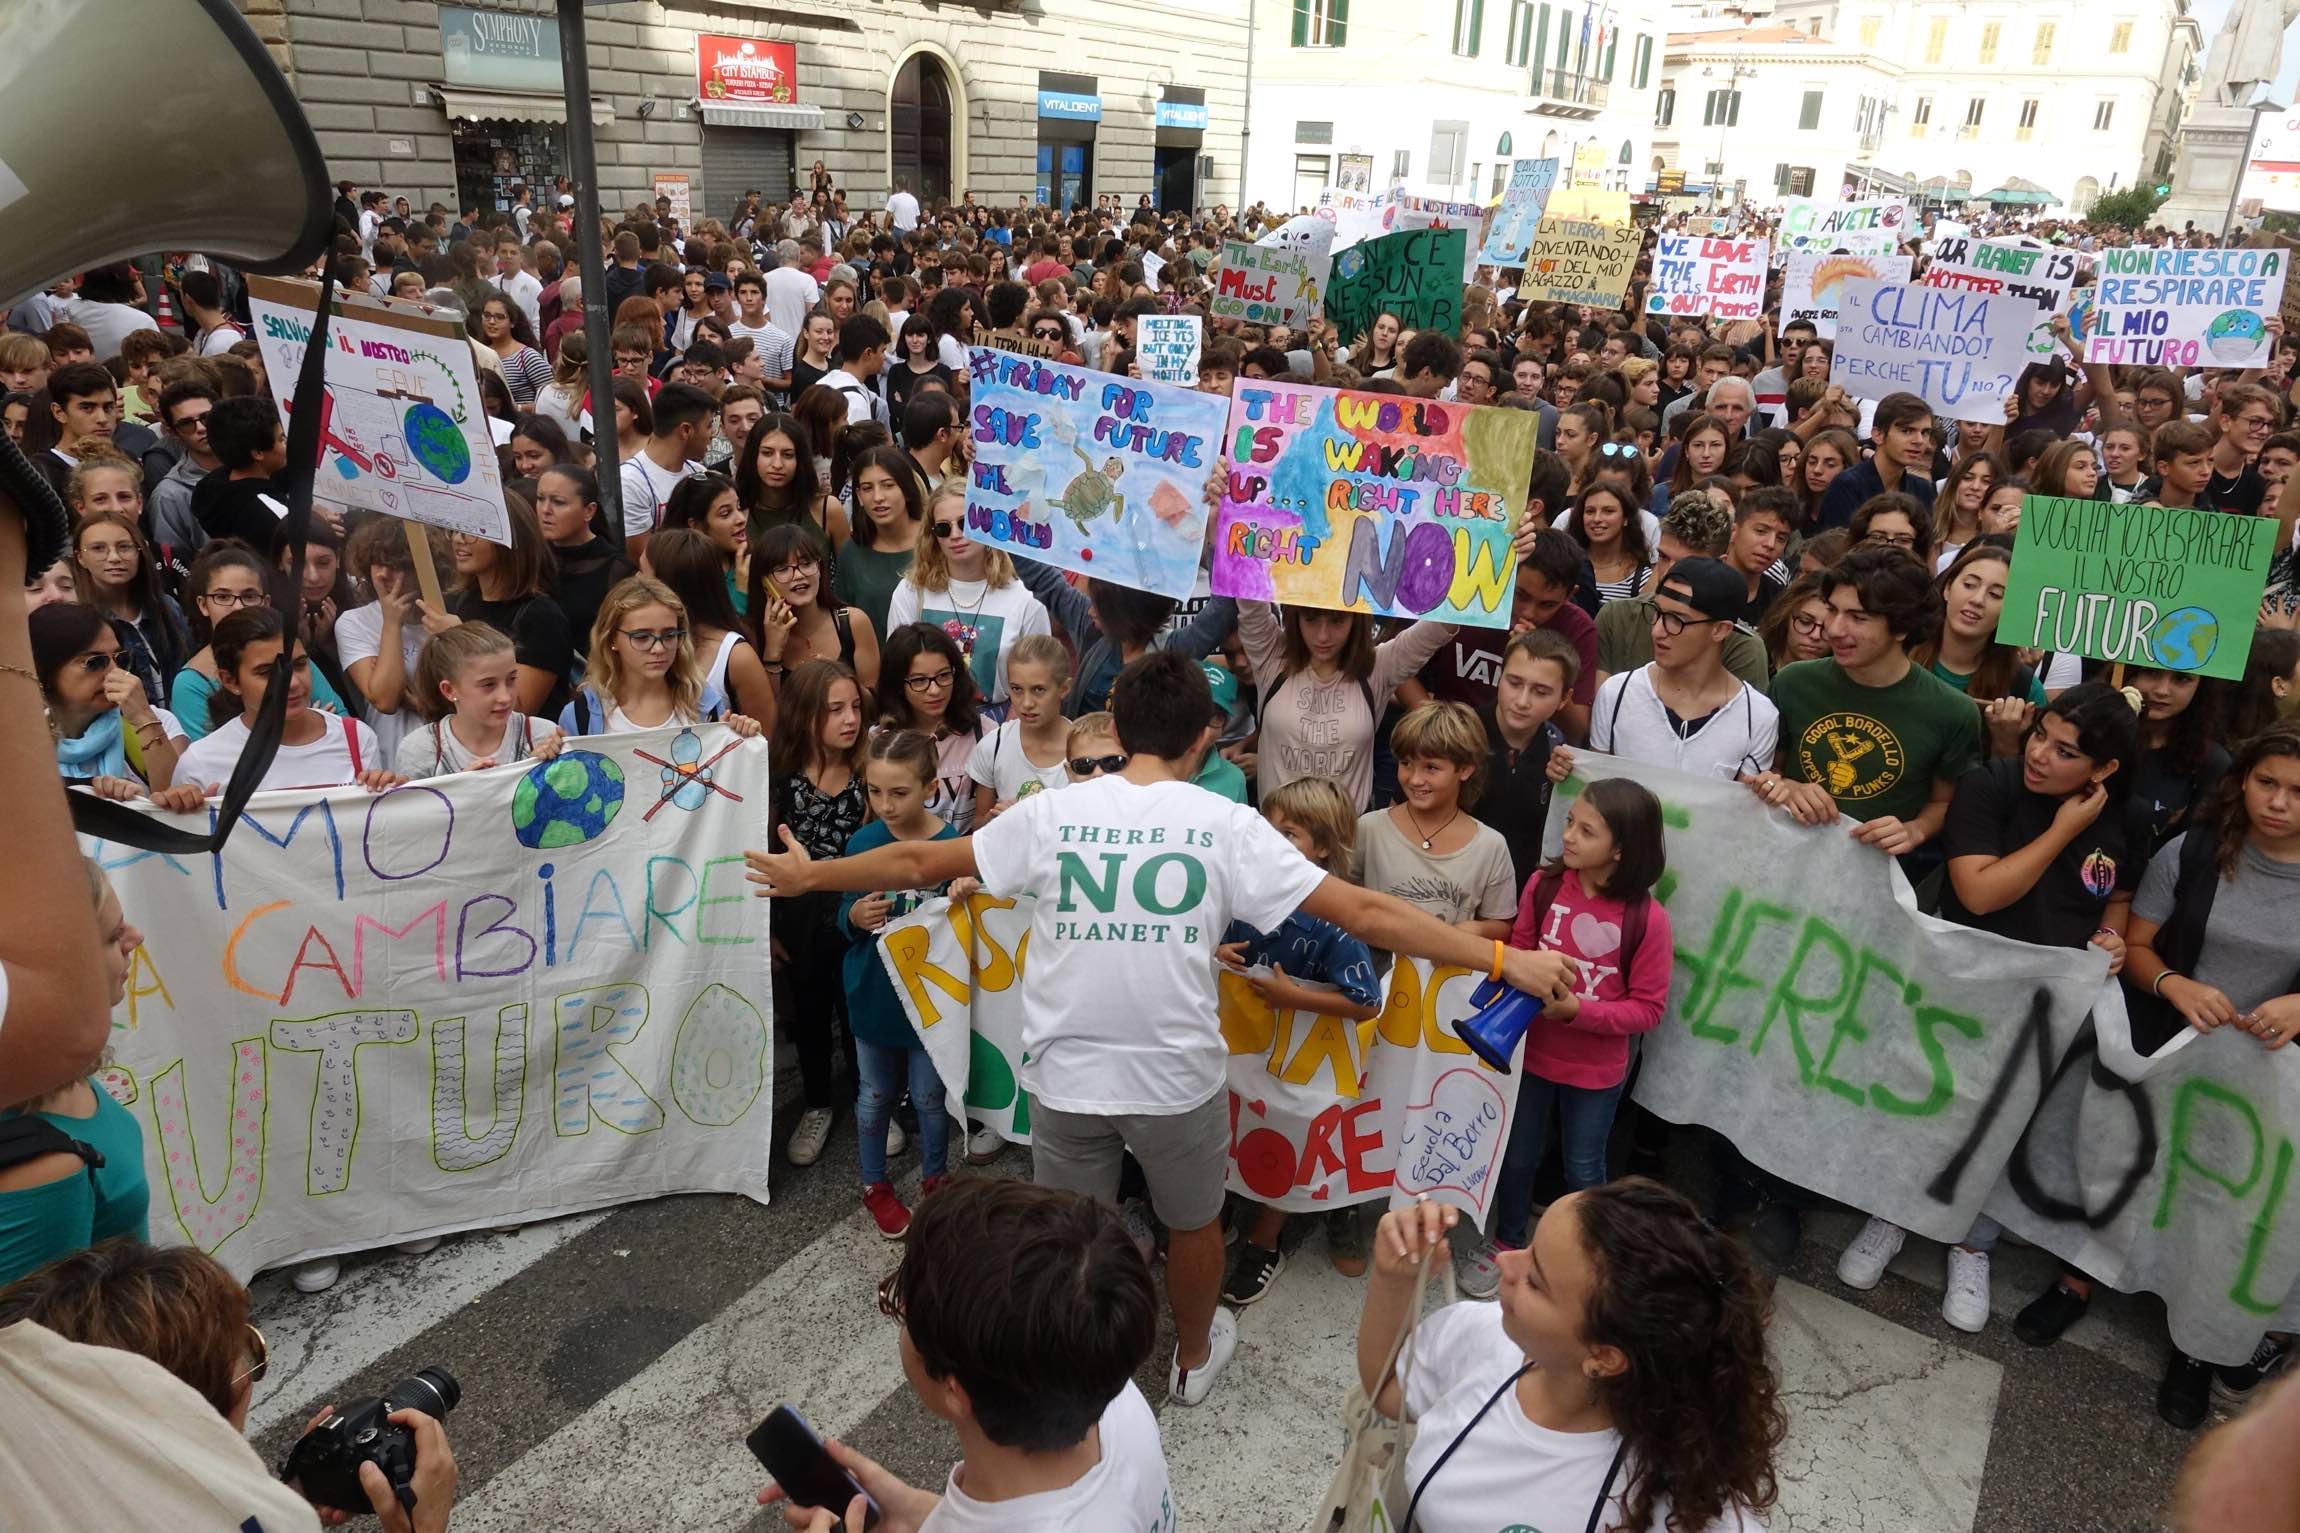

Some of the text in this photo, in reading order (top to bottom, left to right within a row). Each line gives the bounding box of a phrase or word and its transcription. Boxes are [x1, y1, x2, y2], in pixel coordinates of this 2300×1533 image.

[473, 12, 542, 56] SYMPHONY
[722, 66, 776, 80] CITY ISTANBUL
[1044, 99, 1099, 113] VITALDENT
[1161, 110, 1206, 122] VITALDENT
[1422, 199, 1458, 215] NOSTRO
[1820, 207, 1882, 233] AVETE
[1538, 219, 1641, 245] LA TERRA STA
[1225, 243, 1308, 276] The Earth
[1534, 240, 1622, 261] DIVENTANDO
[1660, 238, 1755, 263] WE LOVE
[1935, 237, 1968, 265] OUR
[1972, 243, 2043, 276] PLANET
[2045, 251, 2076, 281] iS
[2104, 249, 2153, 274] NON
[2154, 251, 2257, 276] RIESCO
[2260, 252, 2280, 277] A
[1522, 272, 1583, 290] RAGAZZO
[1531, 258, 1623, 277] HOT DEL MIO
[1658, 259, 1696, 281] THE
[1706, 263, 1761, 295] EARTH
[1923, 266, 2004, 294] HOTTER
[1218, 268, 1277, 302] Must
[1547, 287, 1622, 308] IMMAGINARIO
[2099, 278, 2266, 306] RESPIRARE
[1213, 297, 1245, 315] GO
[1430, 299, 1452, 332] B
[1709, 297, 1760, 317] home
[1849, 286, 1991, 334] IL CLIMA
[2094, 309, 2169, 336] IL MIO
[262, 314, 334, 349] SALViAO
[360, 340, 411, 364] NOSTRO
[1143, 343, 1195, 357] BUT ONLY
[1152, 330, 1195, 343] ICE YES
[1862, 325, 1993, 360] CAMBIANDO!
[2091, 338, 2200, 366] FUTURO
[1155, 354, 1168, 368] IN
[1917, 358, 1972, 405] TU
[1102, 382, 1154, 423] FOR
[1240, 388, 1450, 436] THE WORLD
[974, 404, 1042, 449] SAVE
[1094, 415, 1204, 469] FUTURE
[1233, 424, 1462, 486] IS WAKING
[972, 460, 1013, 496] THE
[1328, 478, 1421, 515] RIGHT
[1434, 490, 1507, 522] HERE
[967, 501, 1053, 550] WORLD
[2030, 496, 2264, 571] VOGLIAMO RESPIRARE
[1227, 515, 1518, 615] RIGHT NOW
[2072, 553, 2185, 599] IL NOSTRO
[1297, 687, 1346, 714] SAVE
[1300, 717, 1340, 745] THE
[1805, 716, 1900, 767] GOGOL BORDELLO
[1280, 744, 1354, 776] WORLD
[1801, 750, 1895, 797] GYPSY PUNKS
[1059, 824, 1213, 848] THERE IS
[1055, 852, 1208, 916] NO
[222, 855, 756, 1007] CAMBiARE
[1055, 922, 1199, 944] PLANET B
[1543, 903, 1571, 946] I
[98, 983, 767, 1255] UTURO
[1926, 986, 2160, 1231] NO
[1426, 1151, 1461, 1185] Dal
